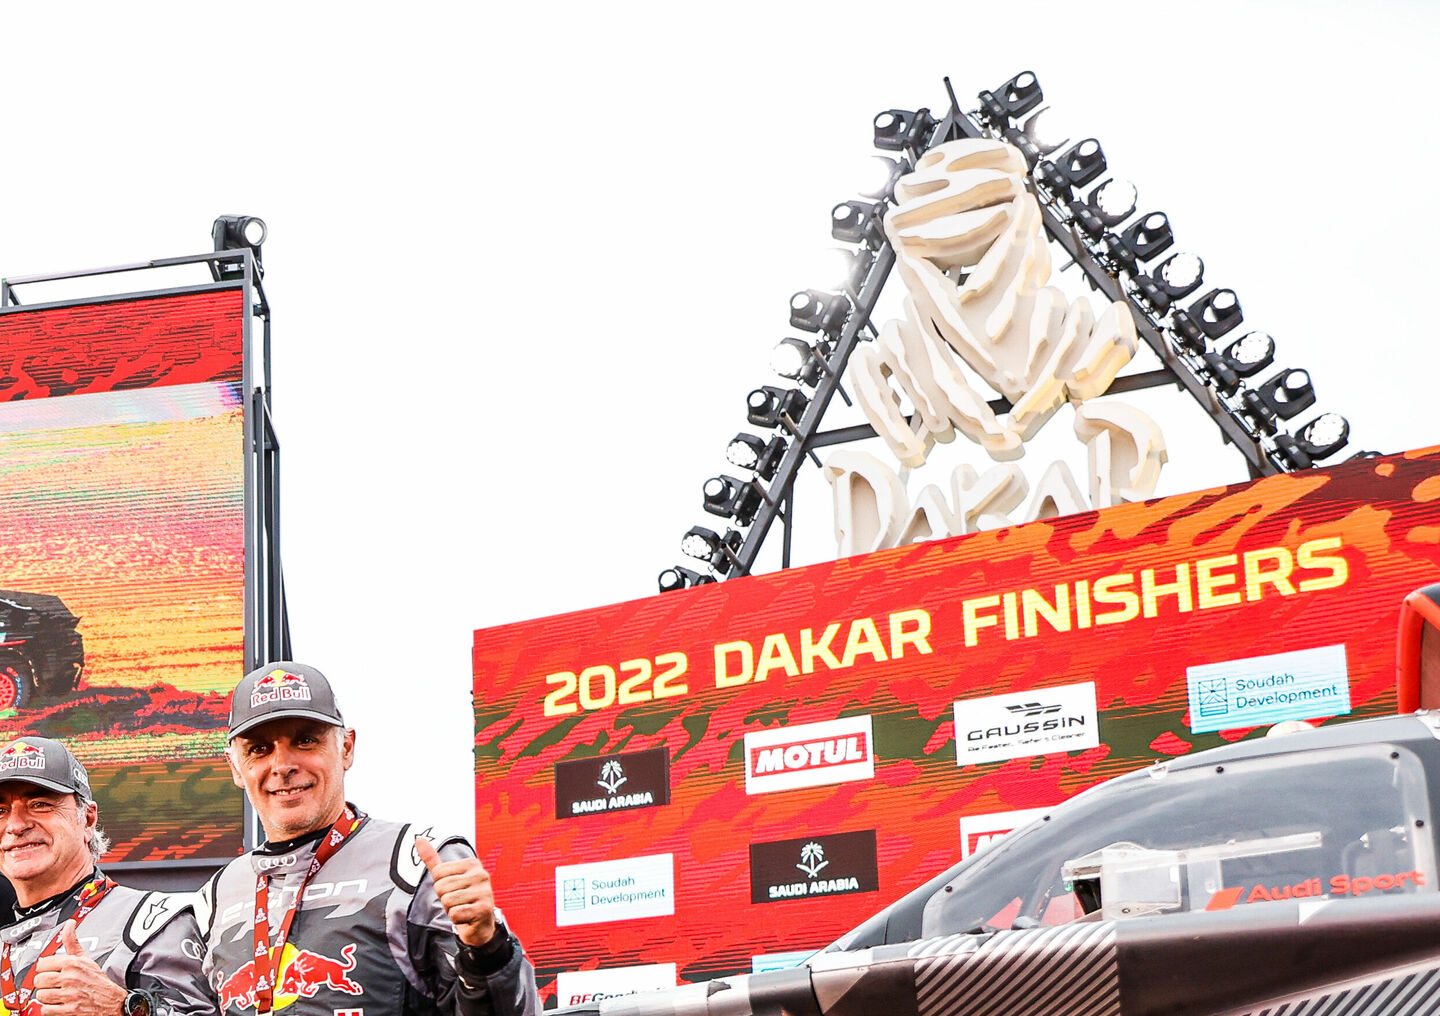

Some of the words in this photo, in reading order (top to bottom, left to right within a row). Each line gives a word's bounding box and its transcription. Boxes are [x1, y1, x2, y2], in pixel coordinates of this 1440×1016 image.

[544, 651, 689, 717] 2022
[714, 608, 934, 689] DAKAR
[962, 536, 1349, 647] FINISHERS
[1235, 671, 1295, 691] Soudah
[251, 687, 280, 708] Red
[280, 686, 312, 701] Bull
[1235, 683, 1339, 711] Development
[18, 757, 46, 769] Bull
[756, 737, 863, 773] MOTUL
[571, 796, 608, 814] SAUDI
[608, 791, 654, 810] ARABIA
[591, 875, 636, 892] Soudah
[768, 880, 808, 899] SAUDI
[809, 875, 860, 894] ARABIA
[1245, 877, 1323, 904] Audi
[1329, 869, 1428, 897] Sport
[591, 887, 666, 906] Development
